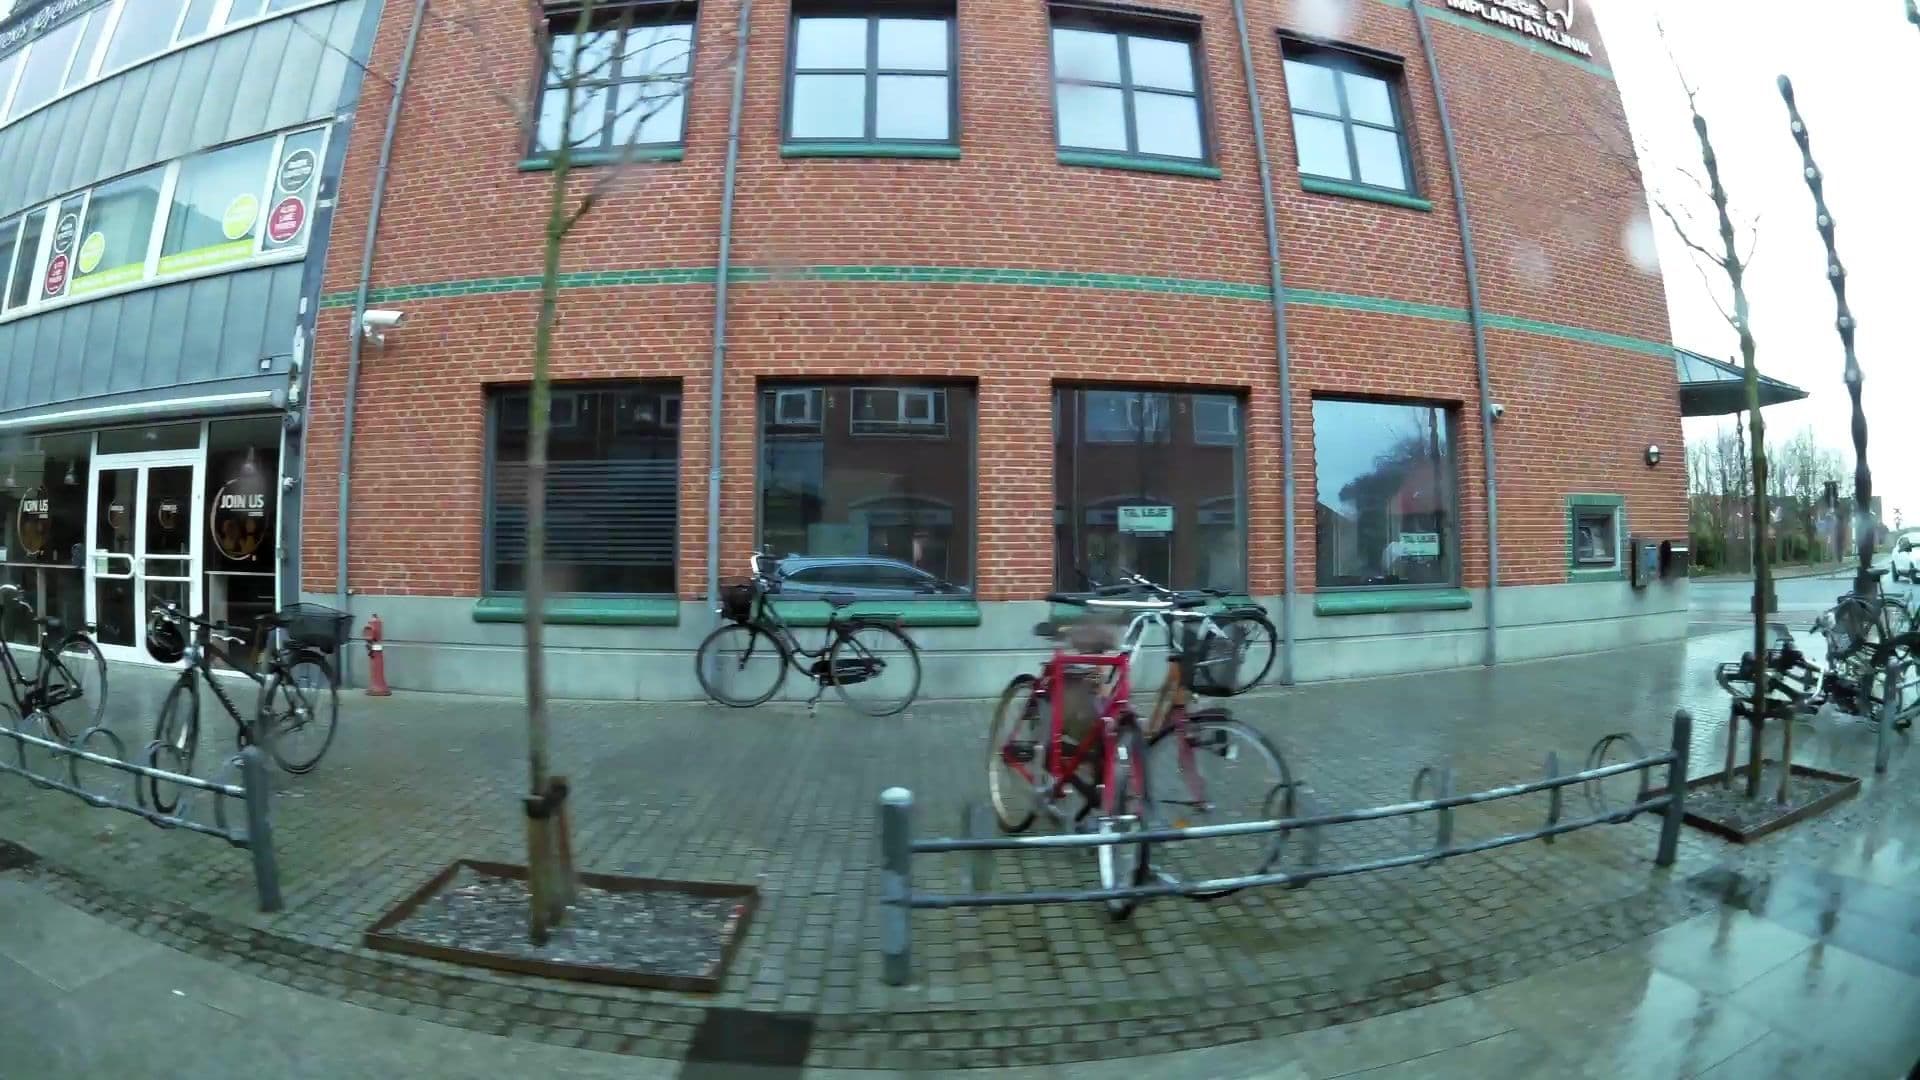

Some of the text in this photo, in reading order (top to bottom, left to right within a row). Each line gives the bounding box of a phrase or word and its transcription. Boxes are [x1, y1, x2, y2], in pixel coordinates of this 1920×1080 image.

[40, 499, 49, 512] US
[220, 494, 265, 508] JOIN US
